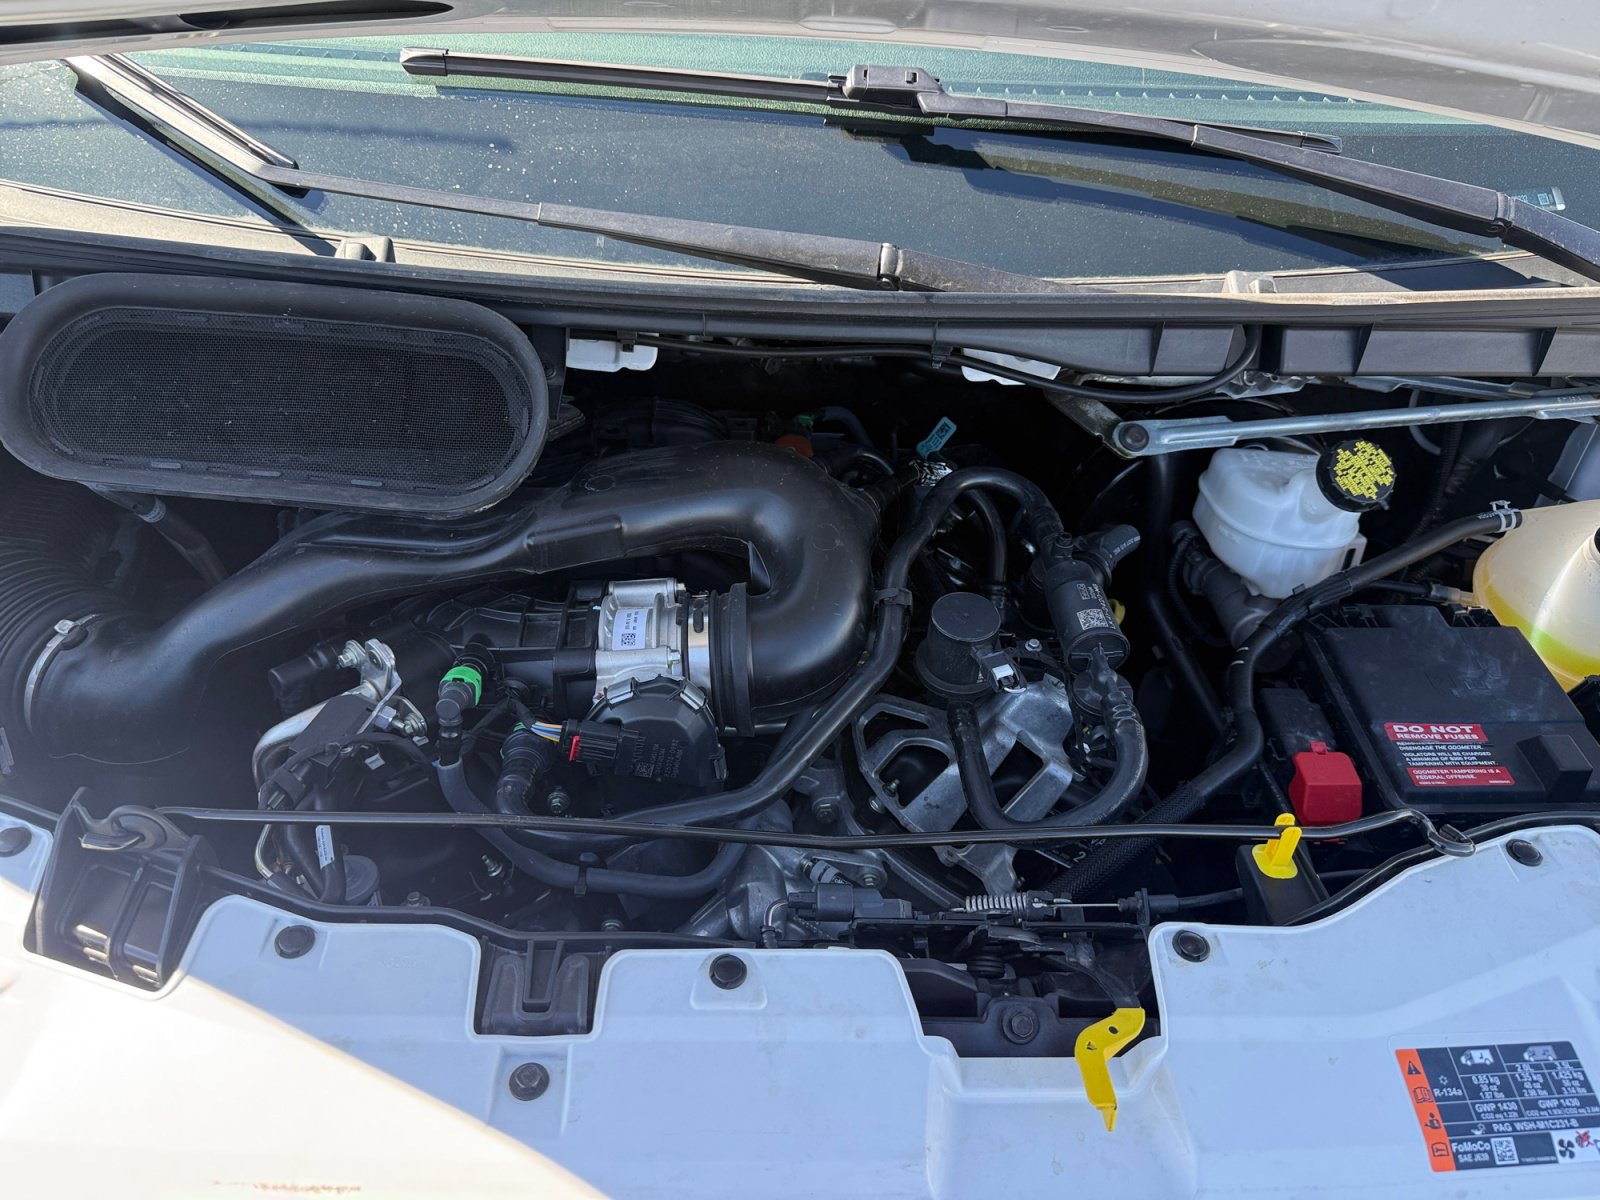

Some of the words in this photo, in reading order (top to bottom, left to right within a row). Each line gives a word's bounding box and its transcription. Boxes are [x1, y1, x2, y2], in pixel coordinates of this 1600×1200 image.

[1393, 725, 1424, 733] DO
[1430, 725, 1473, 733] NOT
[1471, 1075, 1489, 1085] 0.85
[1488, 1074, 1501, 1086] kg
[1515, 1072, 1532, 1081] 1.35
[1531, 1072, 1544, 1083] kg
[1551, 1070, 1573, 1080] 1.425
[1571, 1069, 1585, 1080] kg
[1432, 1087, 1463, 1097] R-134a
[1474, 1103, 1497, 1113] GWP
[1497, 1101, 1518, 1112] 1430
[1537, 1099, 1560, 1109] GWP
[1560, 1098, 1581, 1107] 1430
[1491, 1123, 1513, 1132] PAG
[1451, 1140, 1491, 1153] FoMoCo
[1457, 1154, 1473, 1163] SAE
